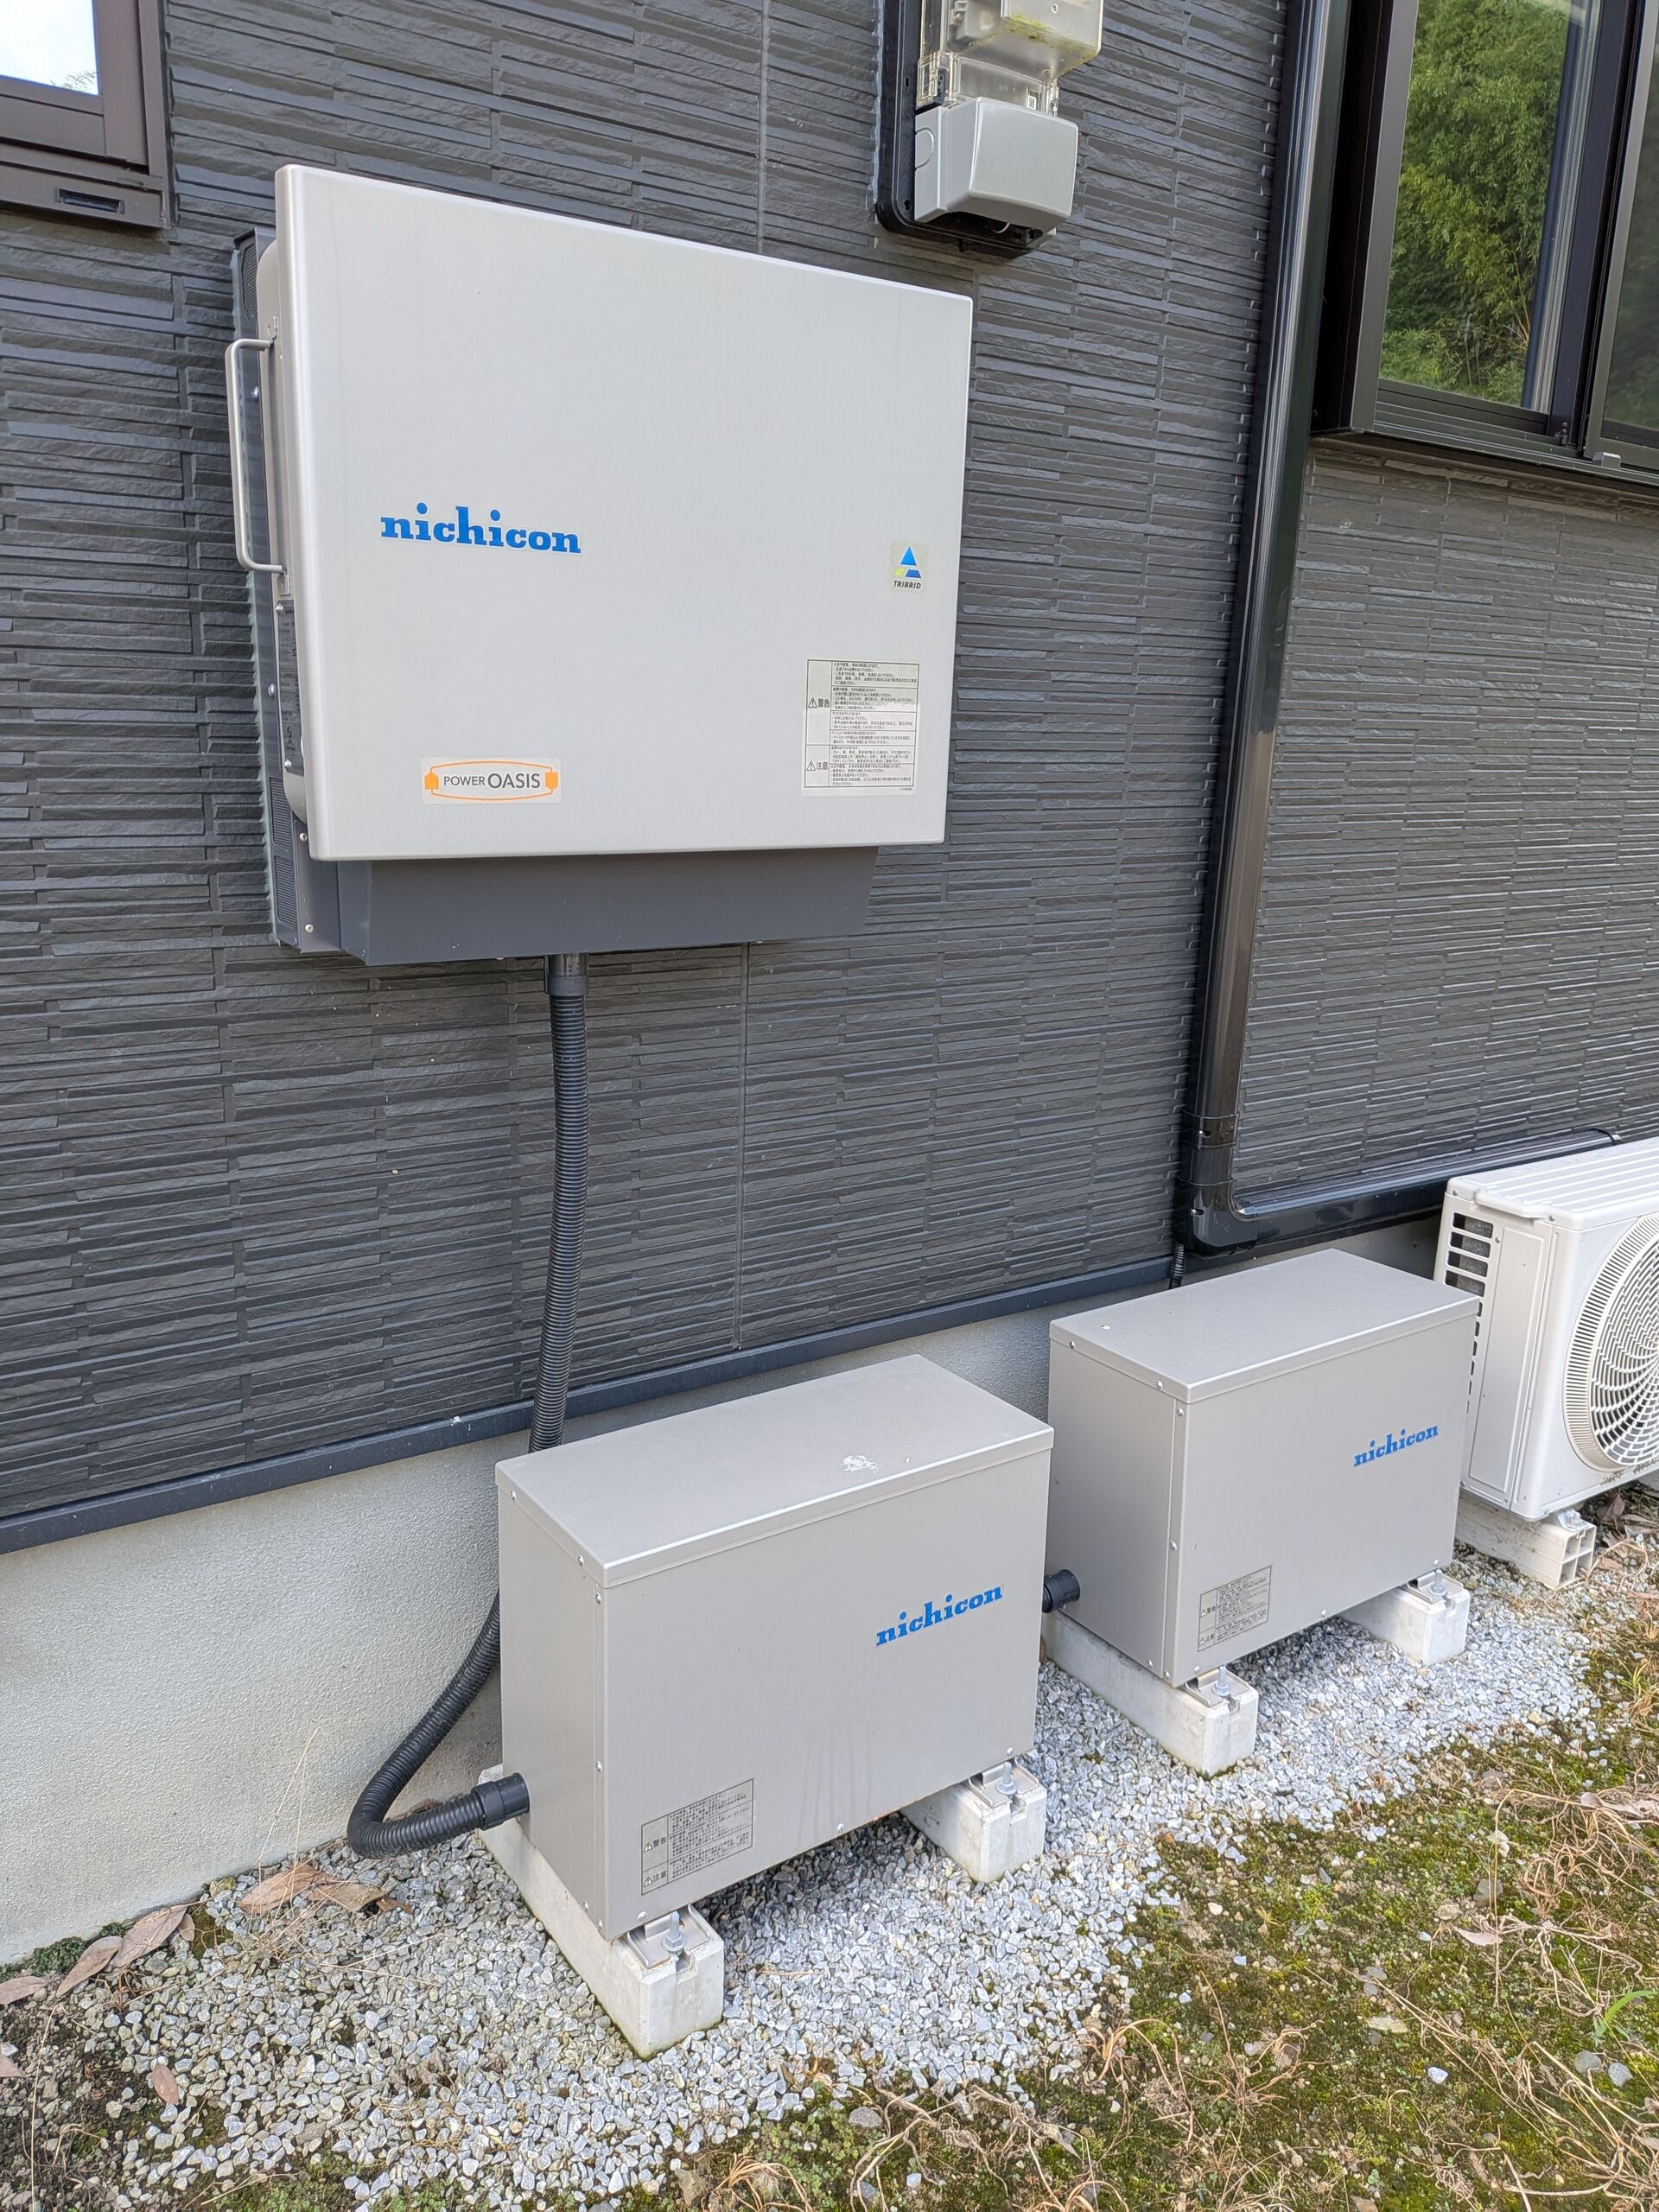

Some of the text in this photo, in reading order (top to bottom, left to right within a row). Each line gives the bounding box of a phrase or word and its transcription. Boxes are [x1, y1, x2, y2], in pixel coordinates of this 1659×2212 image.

[380, 502, 582, 554] nichicon
[893, 580, 922, 589] TRIBRID
[443, 772, 541, 789] POWER OASIS
[1354, 1425, 1439, 1467] nichicon
[876, 1586, 1002, 1646] nichicon
